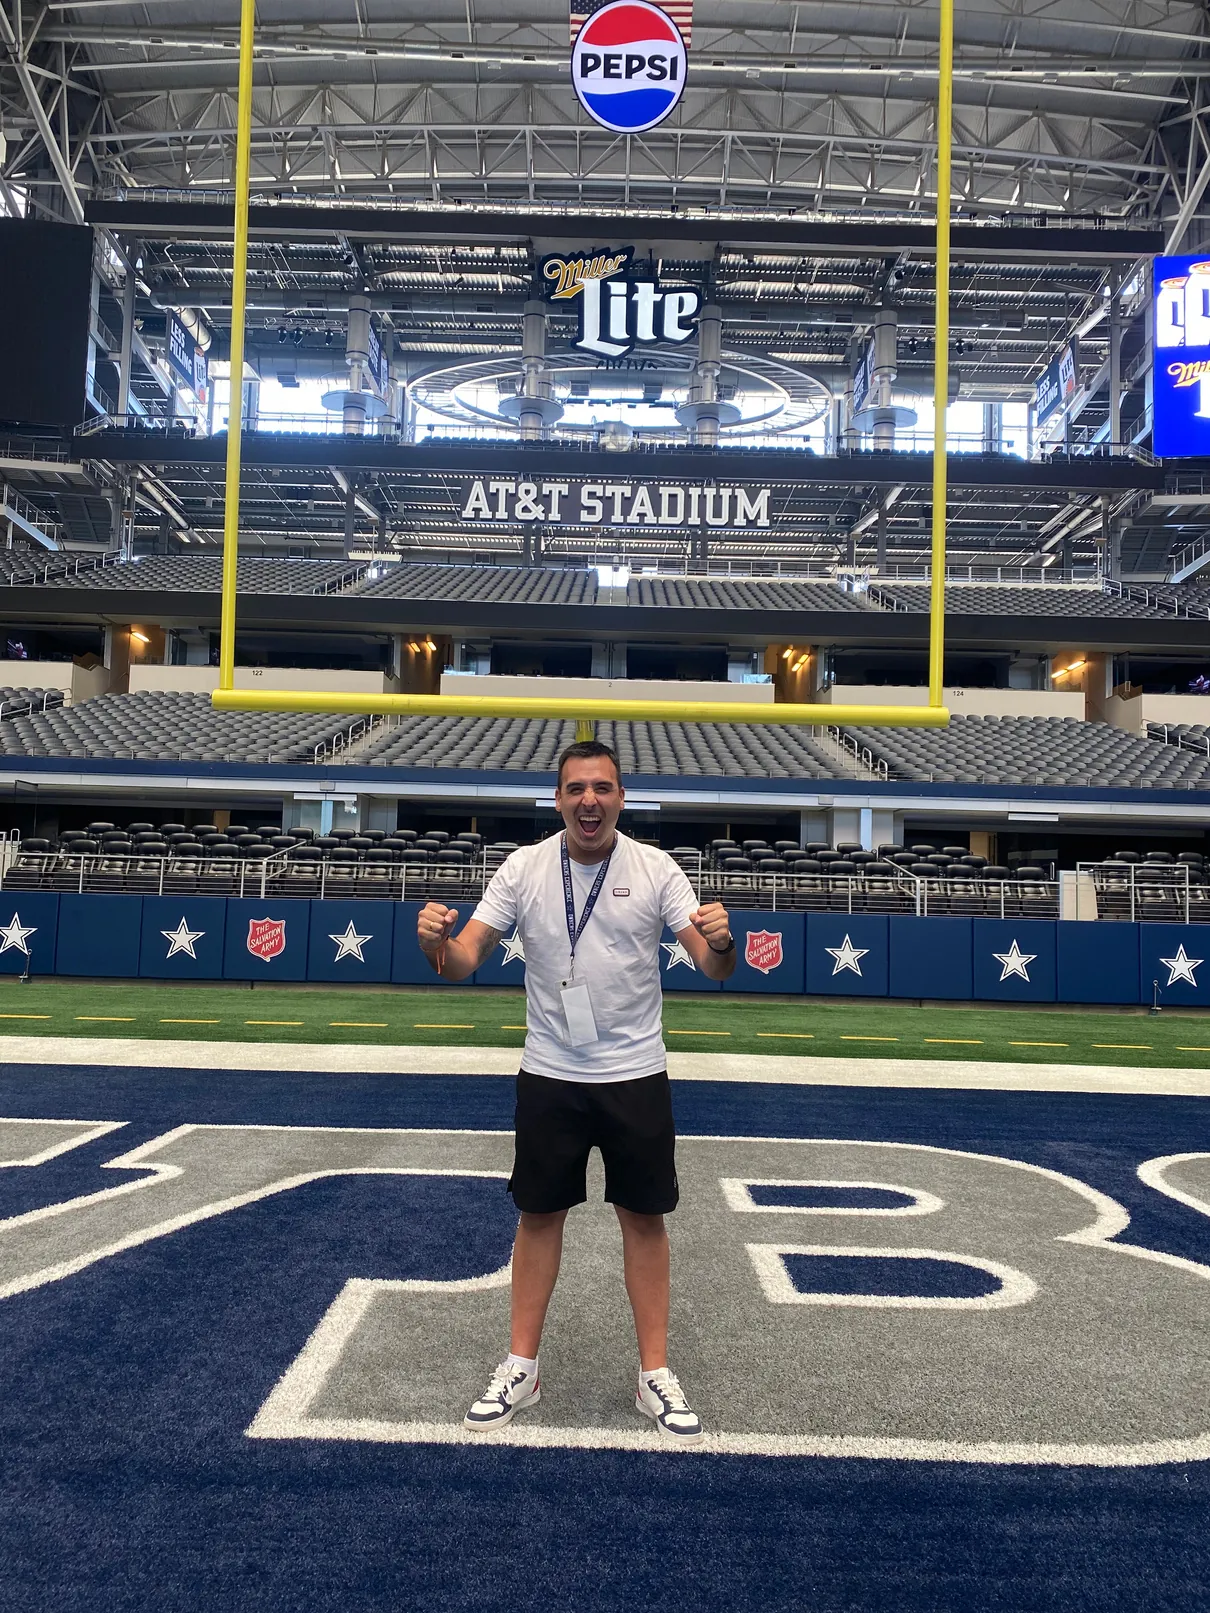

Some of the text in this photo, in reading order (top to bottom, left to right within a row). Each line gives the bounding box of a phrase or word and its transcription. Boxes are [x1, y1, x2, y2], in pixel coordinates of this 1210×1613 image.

[580, 52, 679, 81] PEPSI
[543, 254, 628, 297] Miller
[576, 278, 698, 357] Lite
[171, 318, 186, 348] LESS
[169, 335, 193, 375] FILLING
[1037, 375, 1050, 402] LESS
[1037, 381, 1058, 417] FILLING
[461, 480, 771, 527] AT&T STADIUM
[250, 925, 282, 949] SALVATION
[256, 923, 270, 935] THE
[753, 935, 766, 947] THE
[260, 936, 280, 954] ARMY
[748, 937, 778, 961] SALVATION
[758, 948, 777, 966] ARMY
